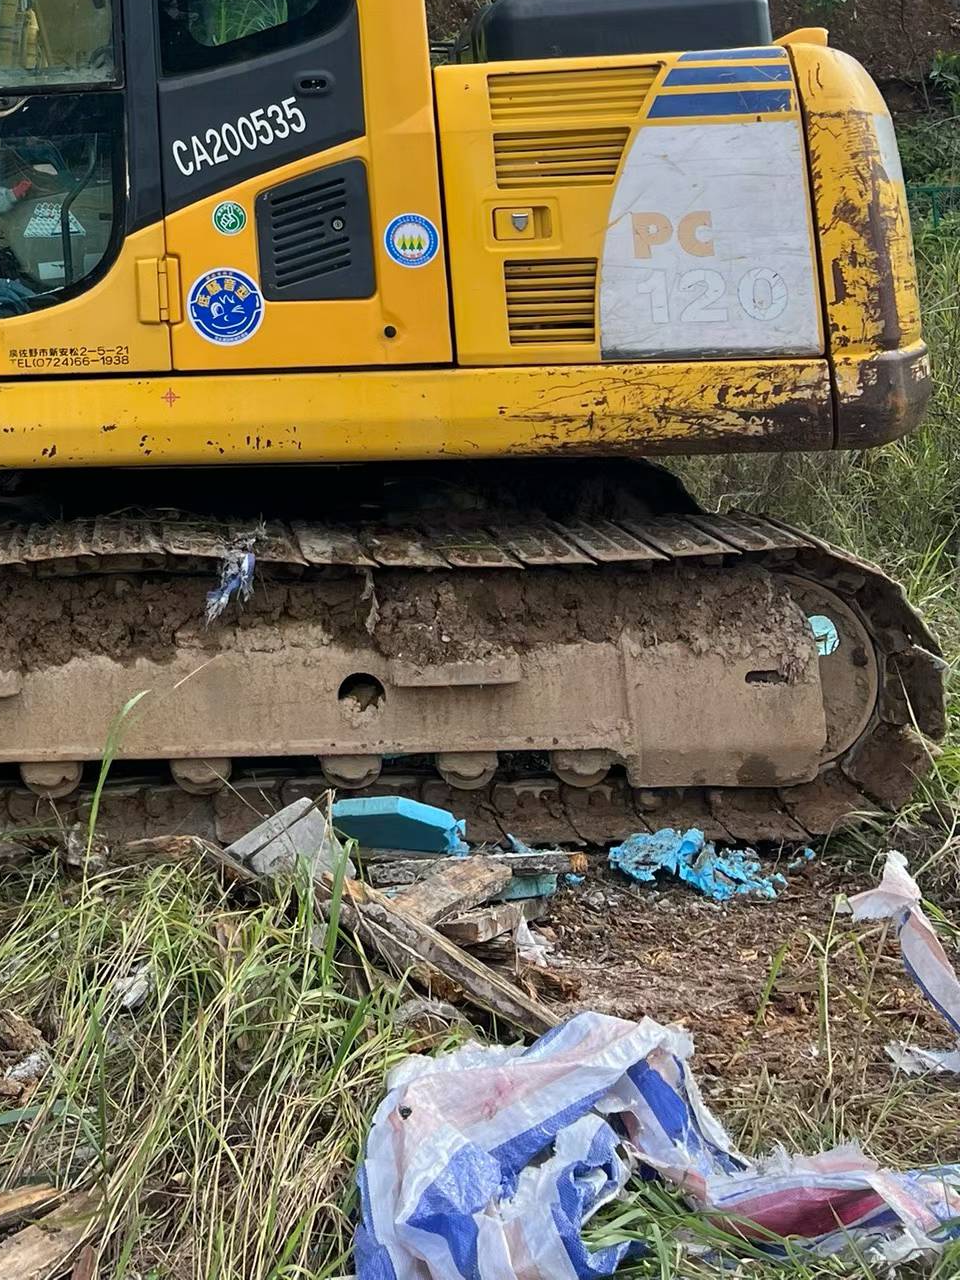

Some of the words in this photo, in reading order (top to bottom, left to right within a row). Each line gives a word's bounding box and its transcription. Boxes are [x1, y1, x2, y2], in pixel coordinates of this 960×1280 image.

[172, 96, 306, 176] CA200535
[631, 210, 715, 259] PC
[638, 267, 789, 323] 120
